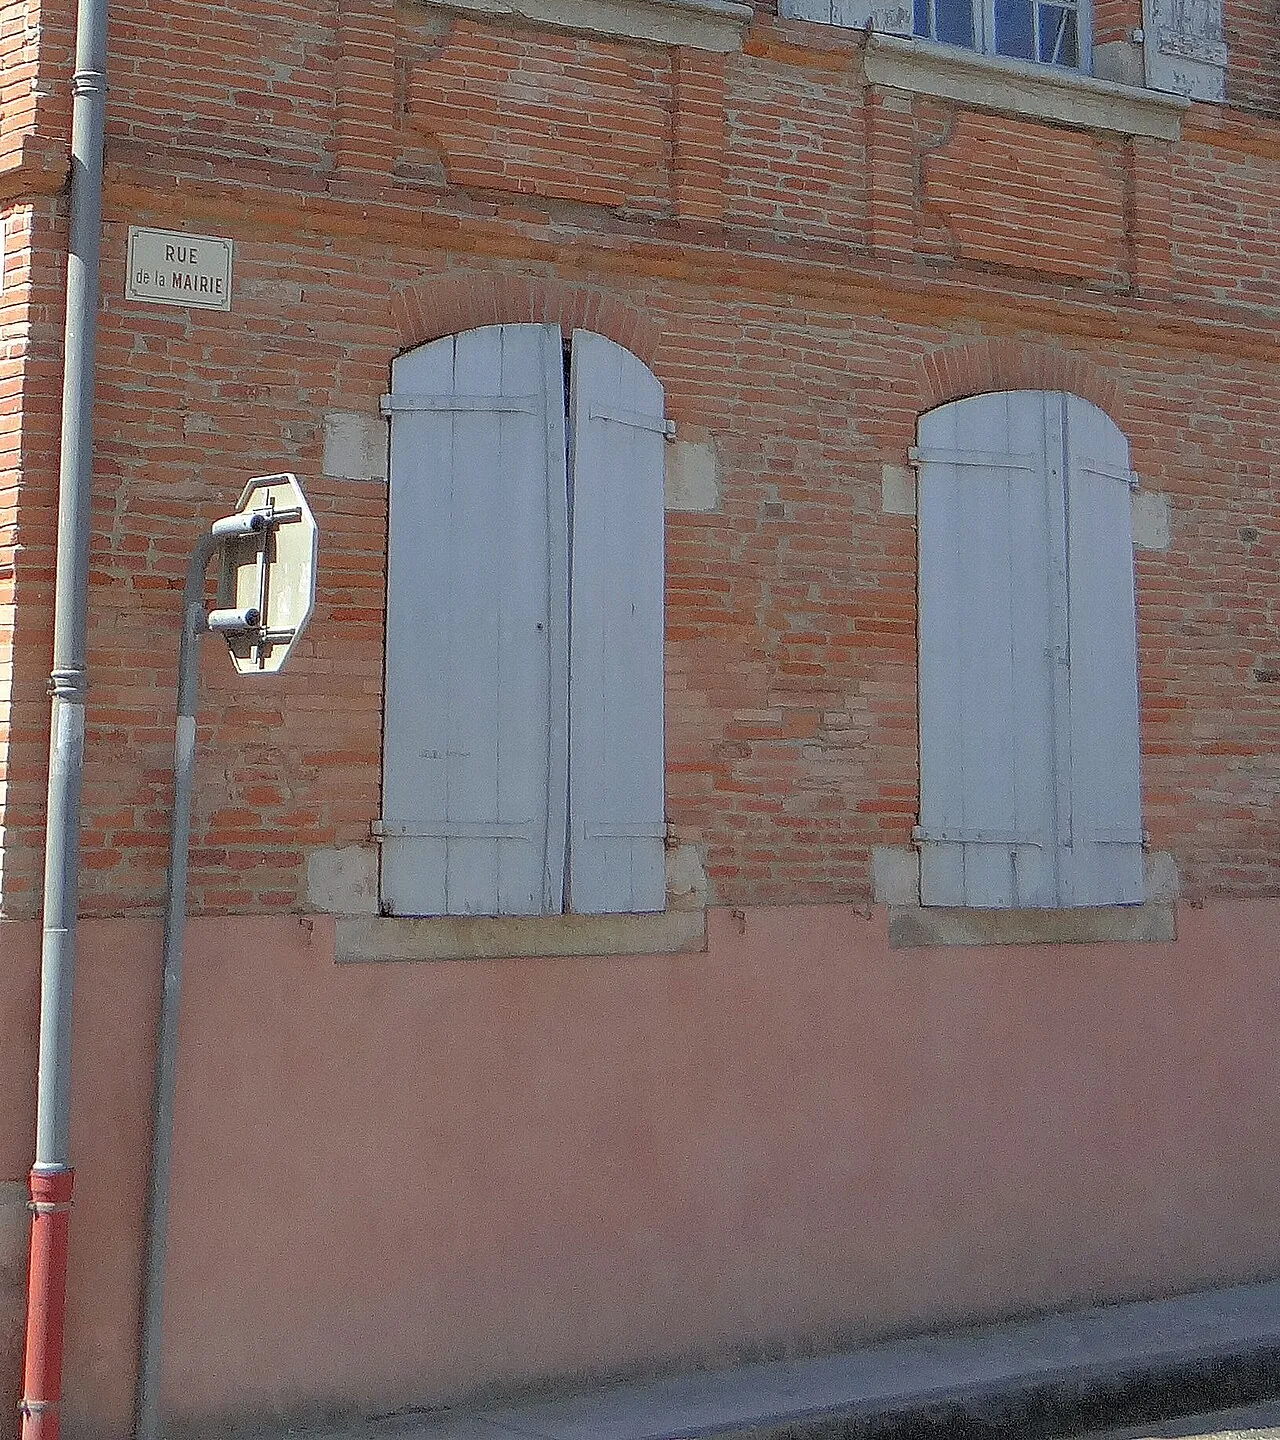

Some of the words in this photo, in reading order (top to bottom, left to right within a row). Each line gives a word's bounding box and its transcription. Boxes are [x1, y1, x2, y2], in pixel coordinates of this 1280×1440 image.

[165, 244, 198, 264] RUE
[136, 268, 150, 285] de
[155, 270, 166, 287] la
[172, 272, 222, 294] MAIRIE
